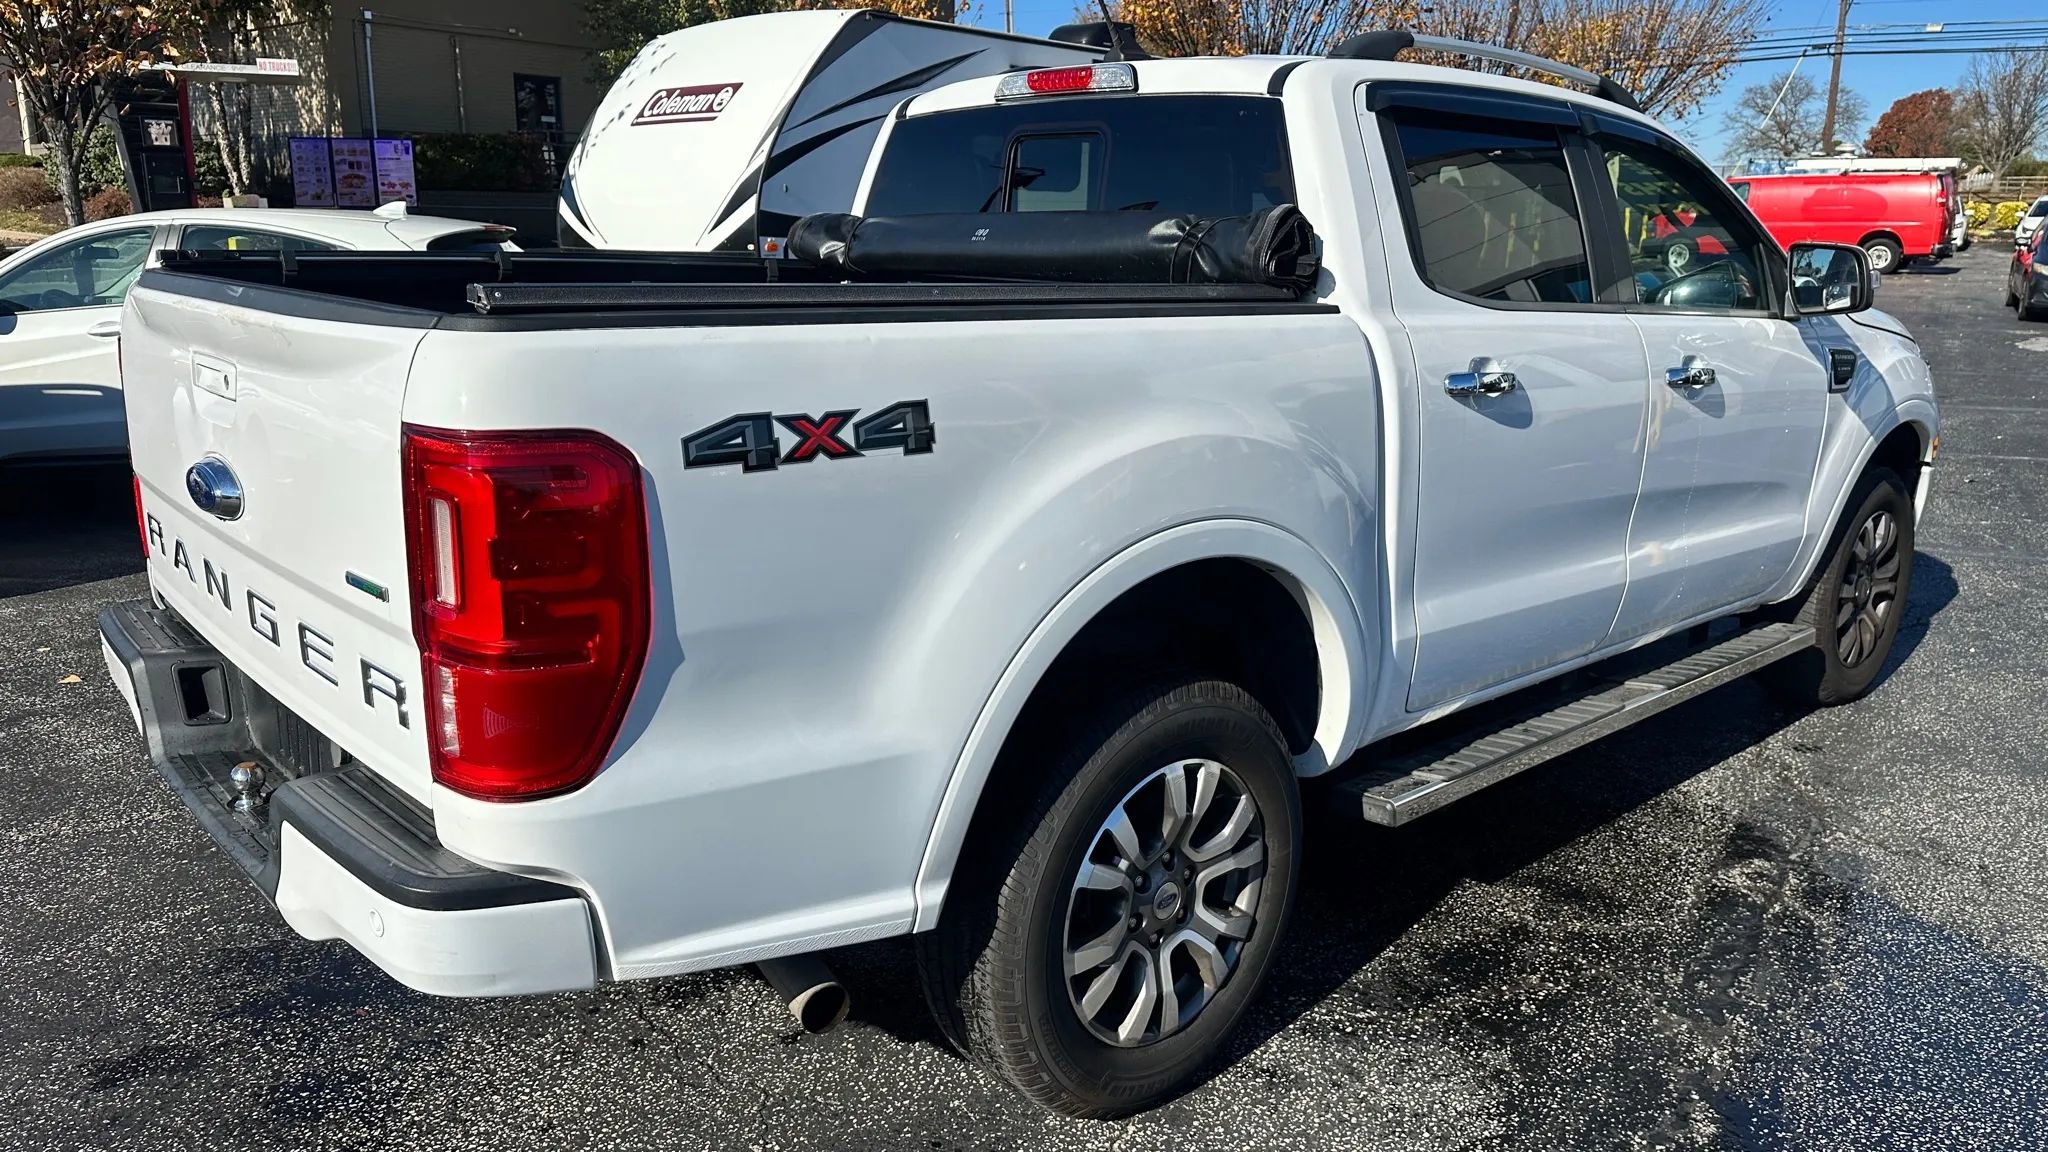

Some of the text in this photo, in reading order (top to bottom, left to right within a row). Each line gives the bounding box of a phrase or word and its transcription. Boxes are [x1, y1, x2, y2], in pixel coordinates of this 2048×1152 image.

[259, 61, 267, 71] NO
[643, 89, 716, 117] Coleman
[147, 511, 410, 730] RANGER
